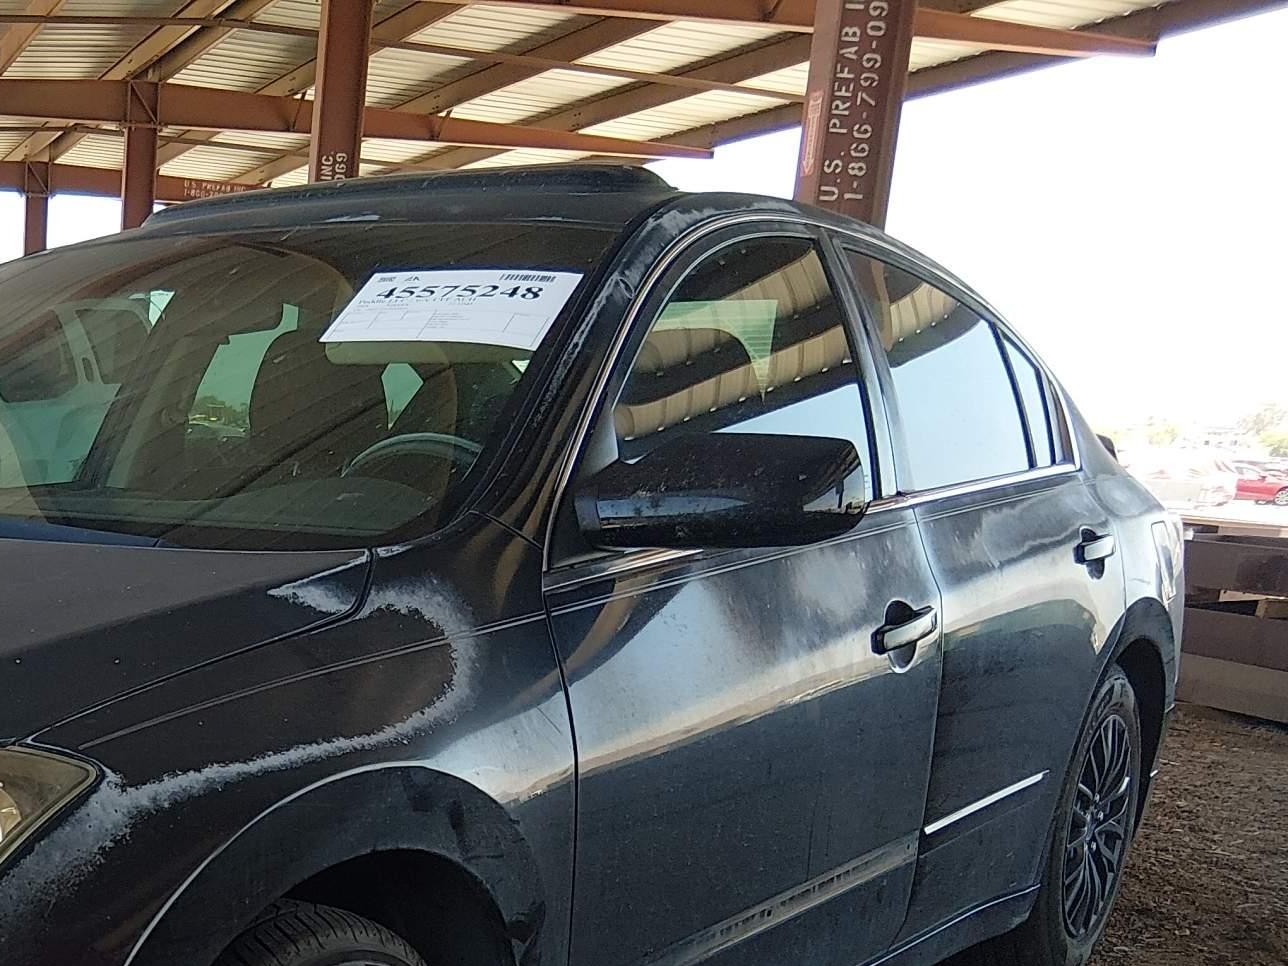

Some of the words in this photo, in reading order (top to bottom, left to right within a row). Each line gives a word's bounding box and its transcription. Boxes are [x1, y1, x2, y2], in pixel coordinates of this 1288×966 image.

[828, 26, 861, 133] PREFAB
[819, 151, 845, 201] U.S.
[376, 284, 544, 300] 45575248
